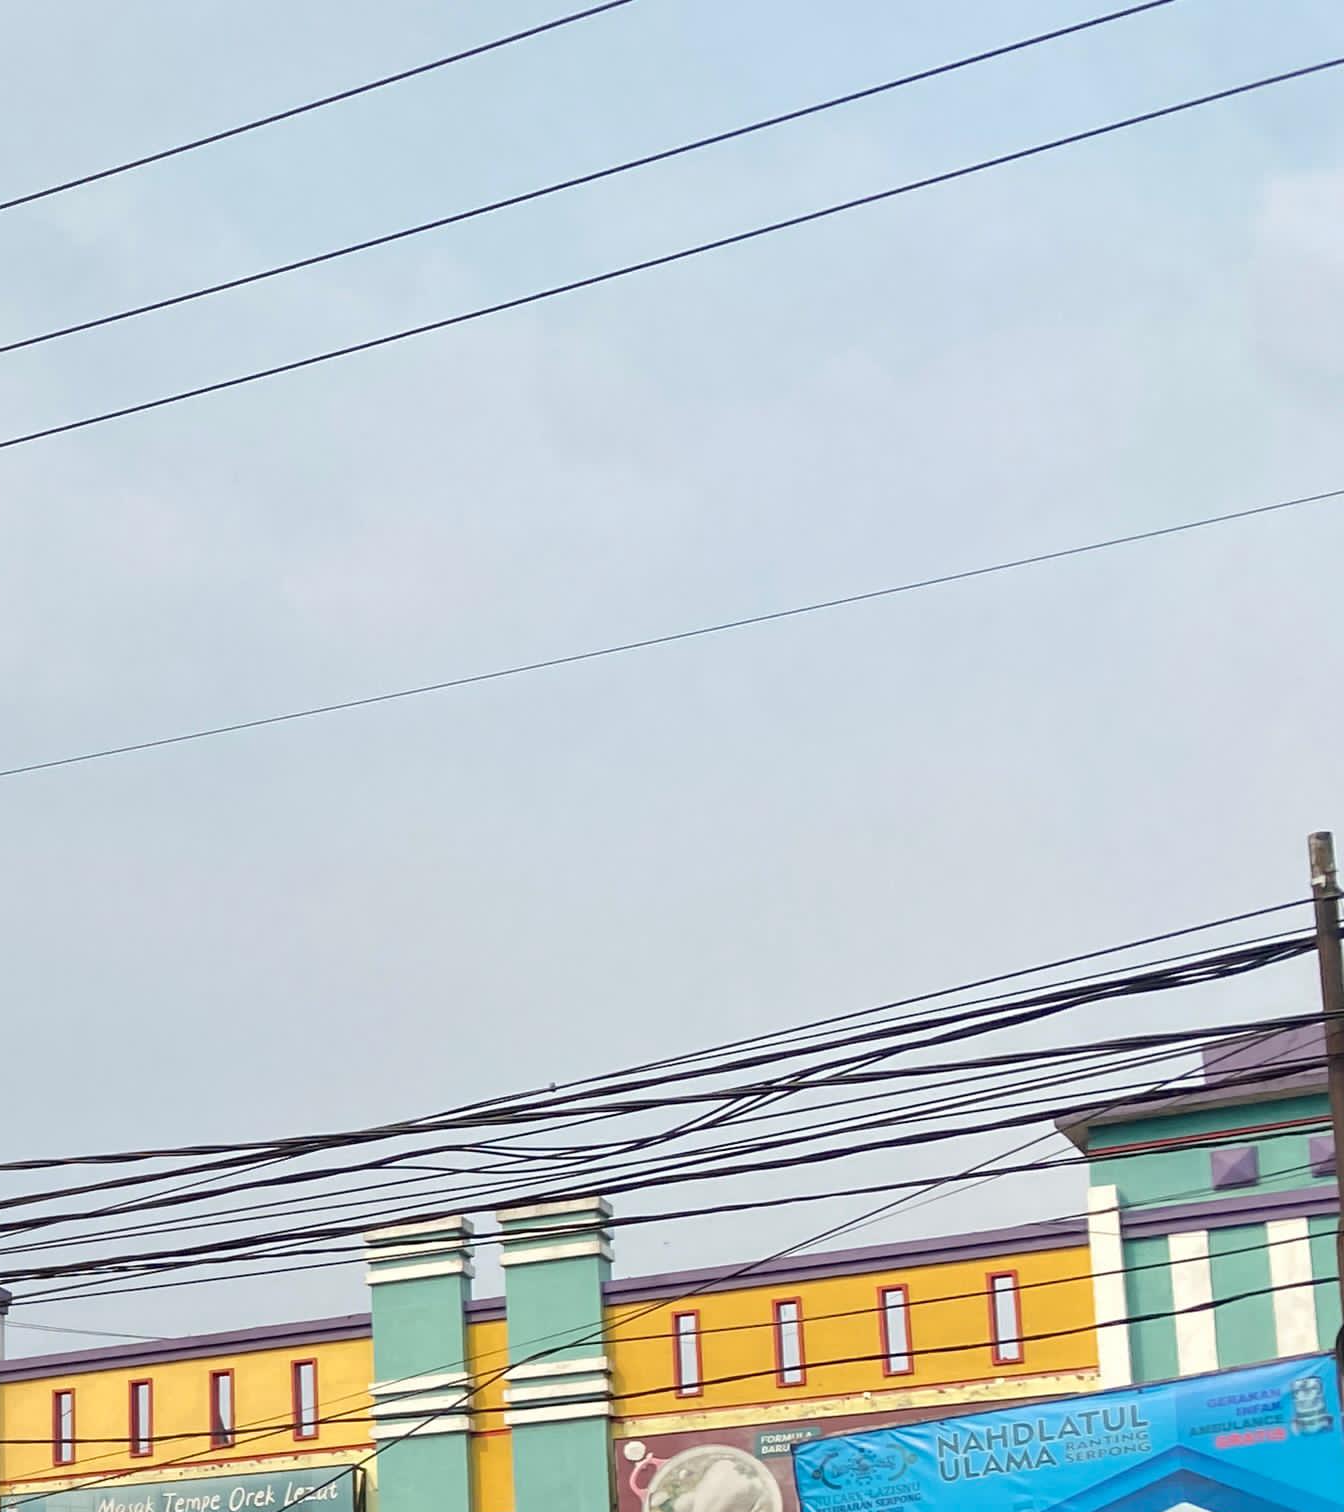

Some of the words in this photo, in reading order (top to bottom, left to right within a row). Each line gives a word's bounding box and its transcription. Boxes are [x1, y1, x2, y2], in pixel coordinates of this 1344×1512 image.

[937, 1405, 1150, 1459] NAHDLATUL
[1188, 1414, 1286, 1438] AMBULANCE
[1065, 1443, 1152, 1463] SERPONG
[1066, 1430, 1149, 1451] RANTING
[937, 1448, 1057, 1482] ULAMA
[229, 1487, 276, 1511] Orek
[284, 1481, 338, 1506] Lezat
